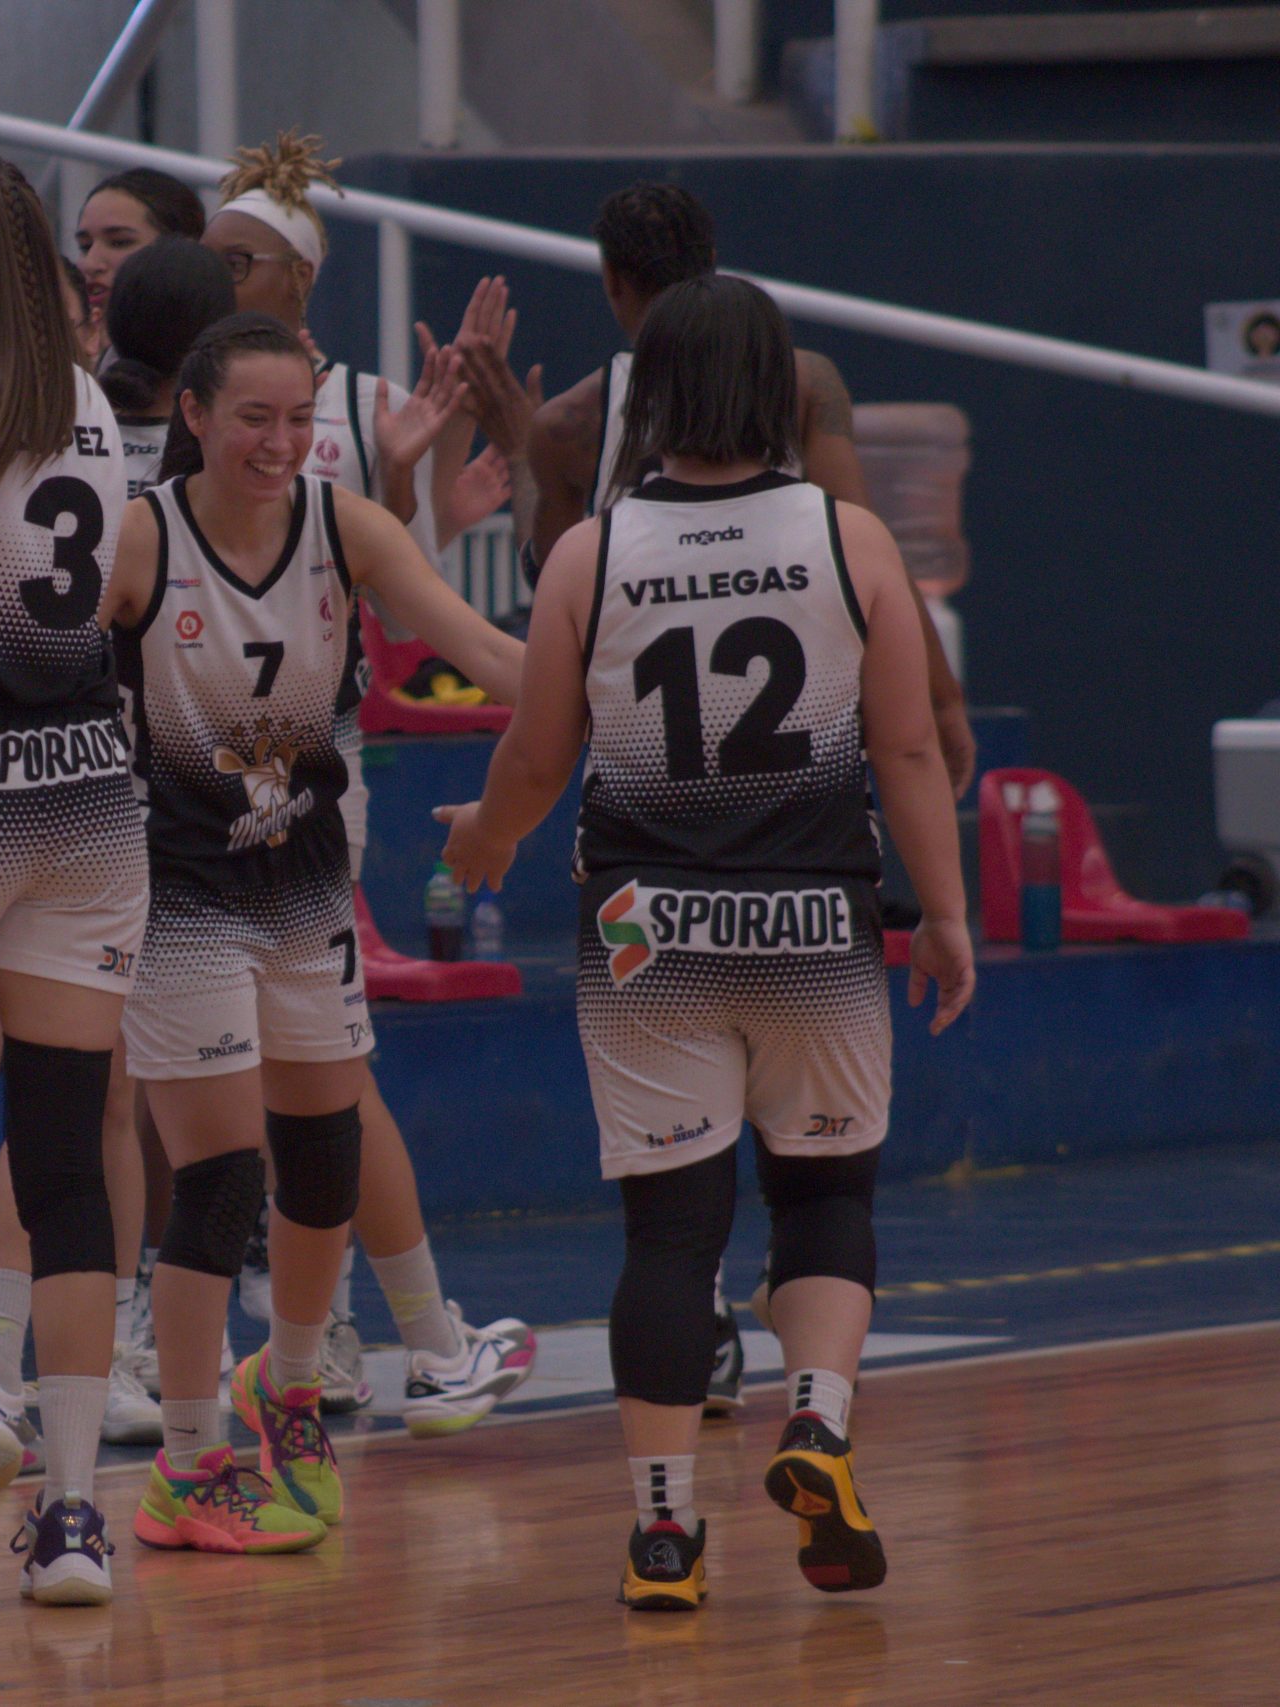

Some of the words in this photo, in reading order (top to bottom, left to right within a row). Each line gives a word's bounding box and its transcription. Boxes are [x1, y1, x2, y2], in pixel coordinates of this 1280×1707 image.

[19, 475, 104, 630] 3
[620, 564, 810, 607] VILLEGAS
[242, 640, 284, 699] 7
[633, 615, 813, 780] 12
[648, 892, 850, 949] SPORADE
[329, 929, 356, 986] 7
[198, 1038, 253, 1061] SPALDING
